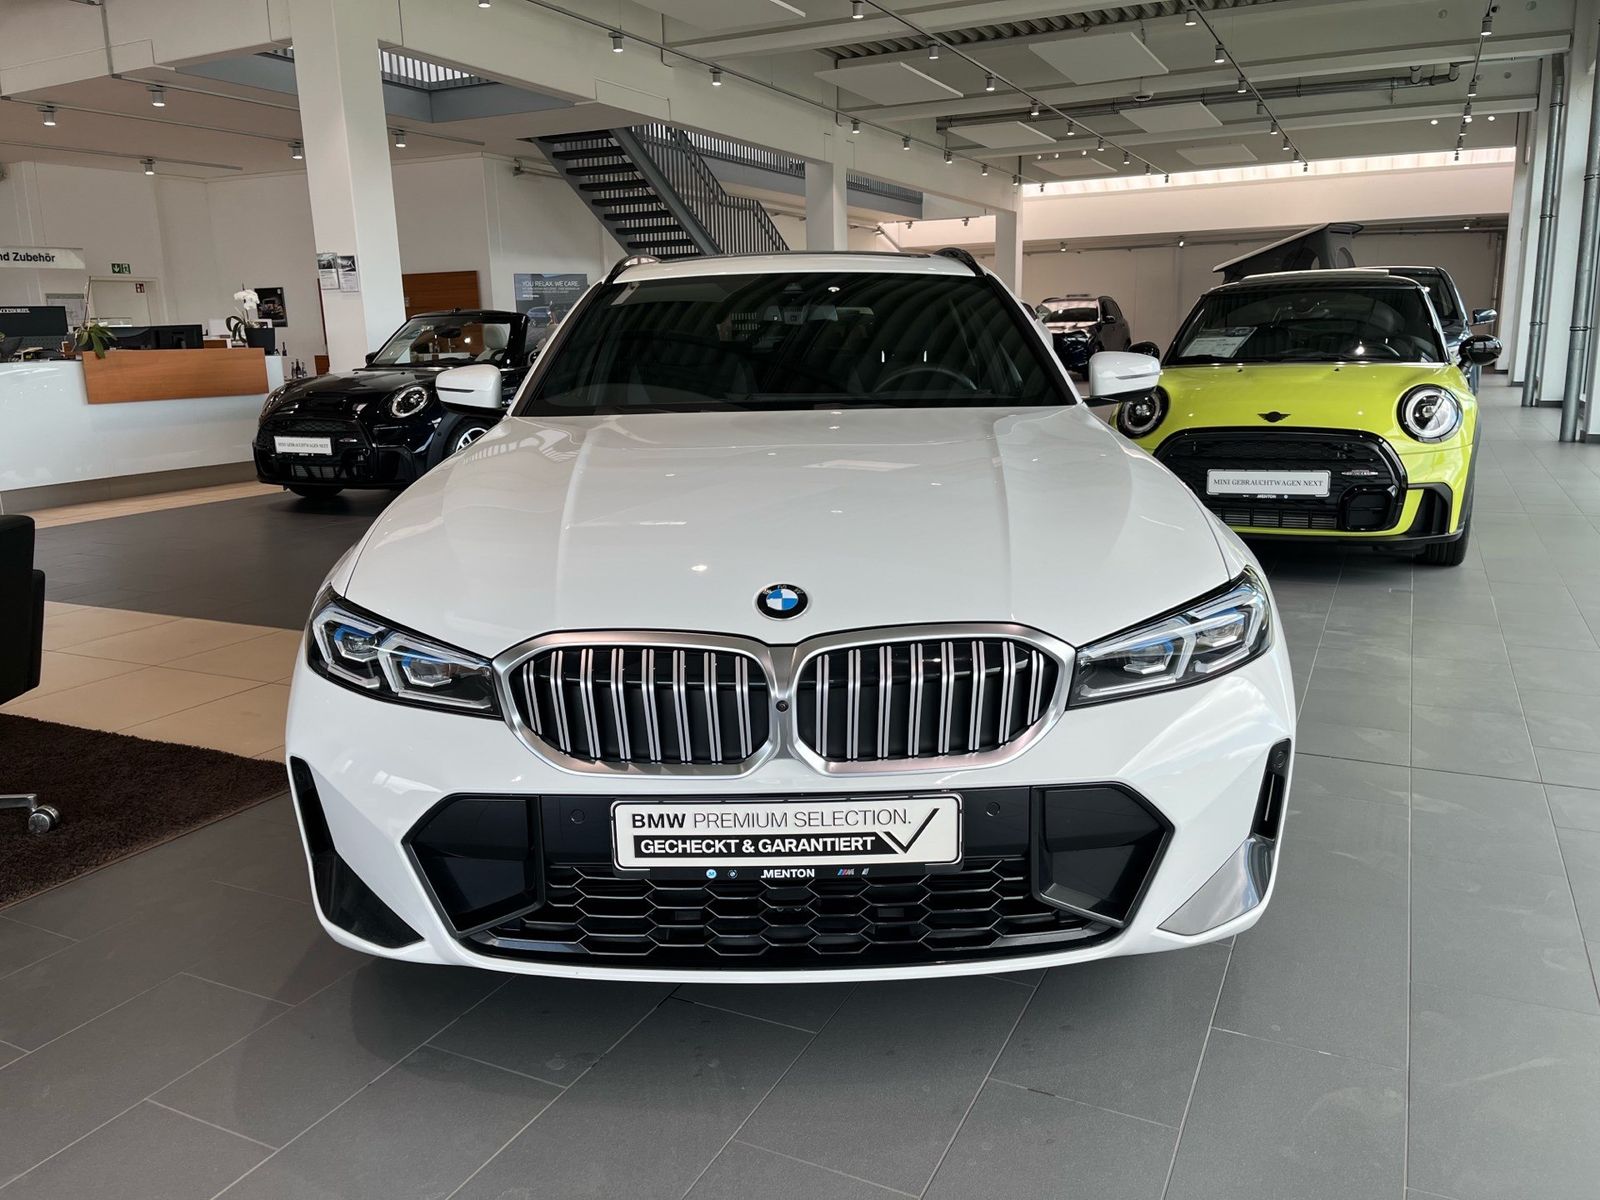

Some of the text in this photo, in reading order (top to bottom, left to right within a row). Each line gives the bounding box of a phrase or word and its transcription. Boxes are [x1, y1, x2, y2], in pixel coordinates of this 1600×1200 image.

[12, 252, 55, 262] Zubehör
[1231, 479, 1302, 487] GEBRAUCHTWAGEN
[631, 808, 912, 829] BMW PREMIUM SELECTION.
[640, 836, 876, 854] GECHECKT & GARANTIERT
[760, 868, 816, 879] MENTON
